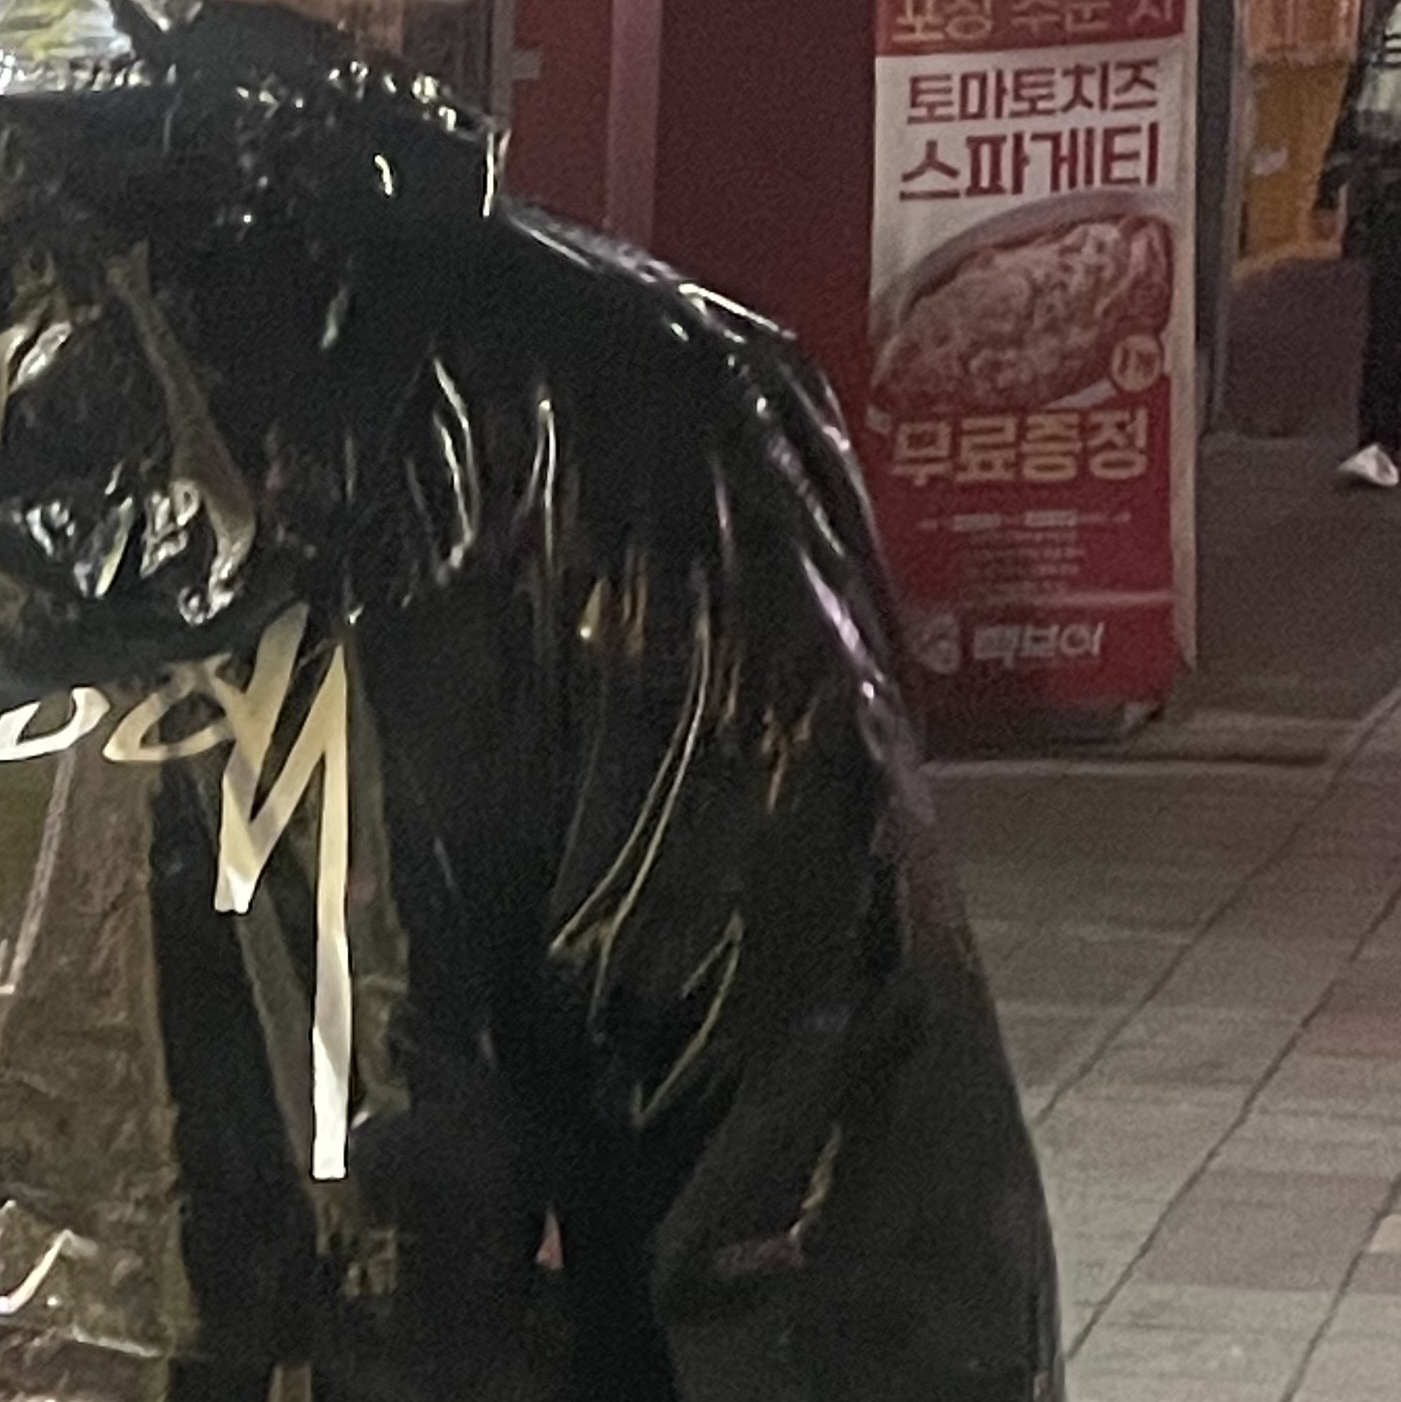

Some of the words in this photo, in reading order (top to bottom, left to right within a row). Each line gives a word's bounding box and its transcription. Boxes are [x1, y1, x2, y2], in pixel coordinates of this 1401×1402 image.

[906, 58, 1158, 125] 토마토치즈
[899, 122, 1160, 201] 스파게티
[890, 406, 1148, 487] 무료증정
